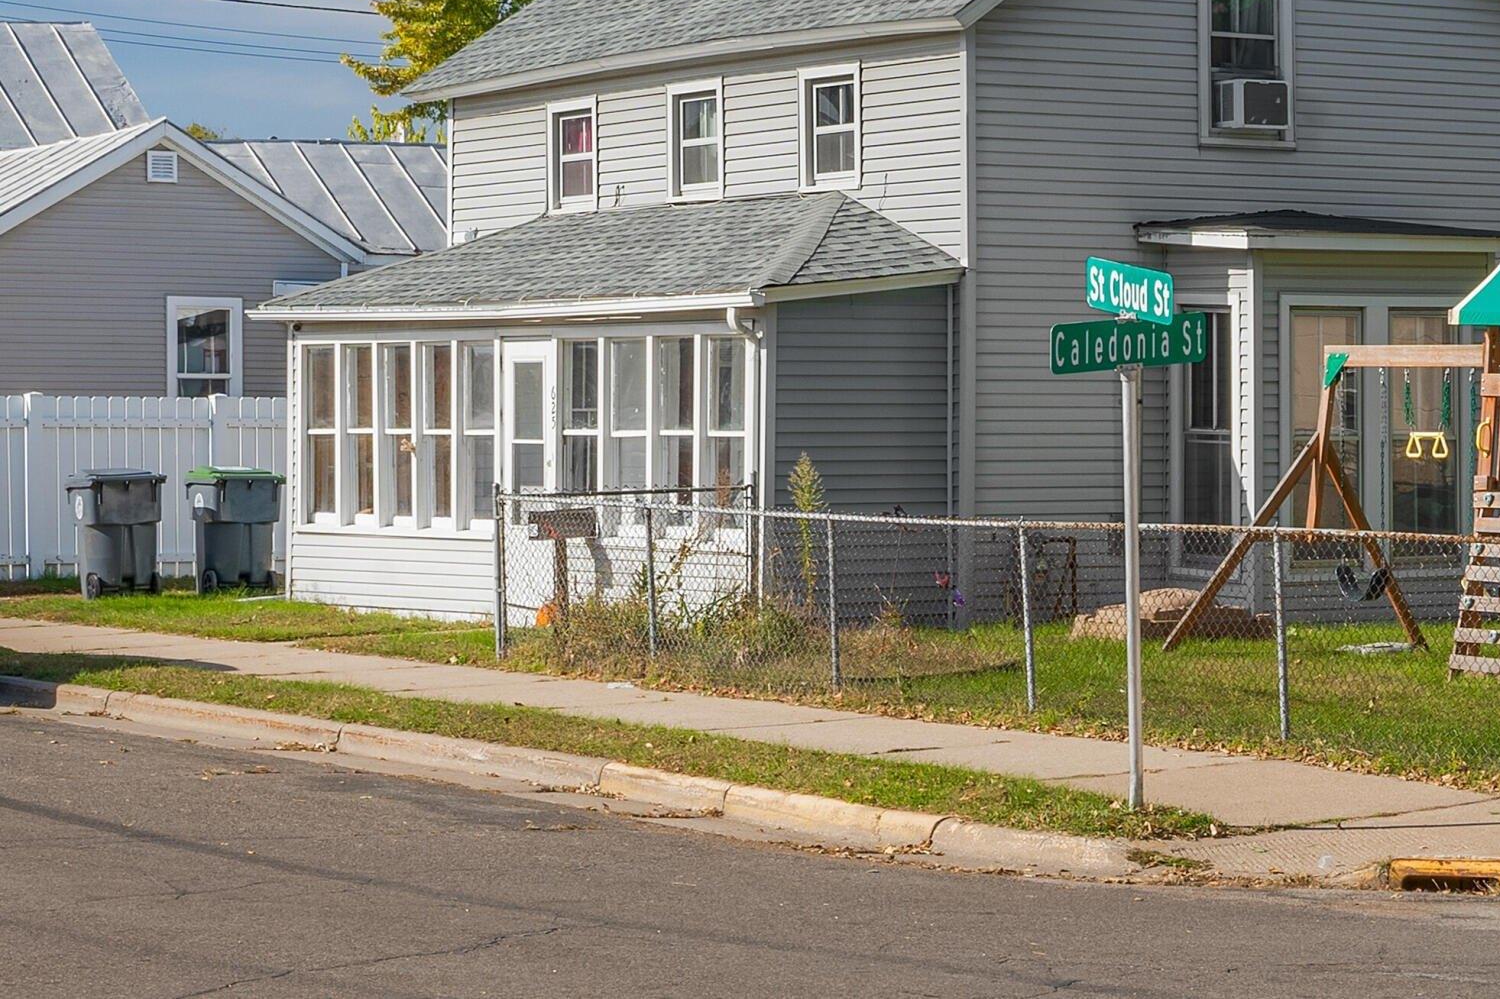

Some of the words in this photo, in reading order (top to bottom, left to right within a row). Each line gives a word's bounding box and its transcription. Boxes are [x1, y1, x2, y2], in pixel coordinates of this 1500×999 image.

[1089, 265, 1105, 303] St
[1109, 270, 1148, 313] Cloud
[1154, 279, 1170, 318] St
[1055, 324, 1170, 367] Caledonia
[1182, 320, 1203, 356] St
